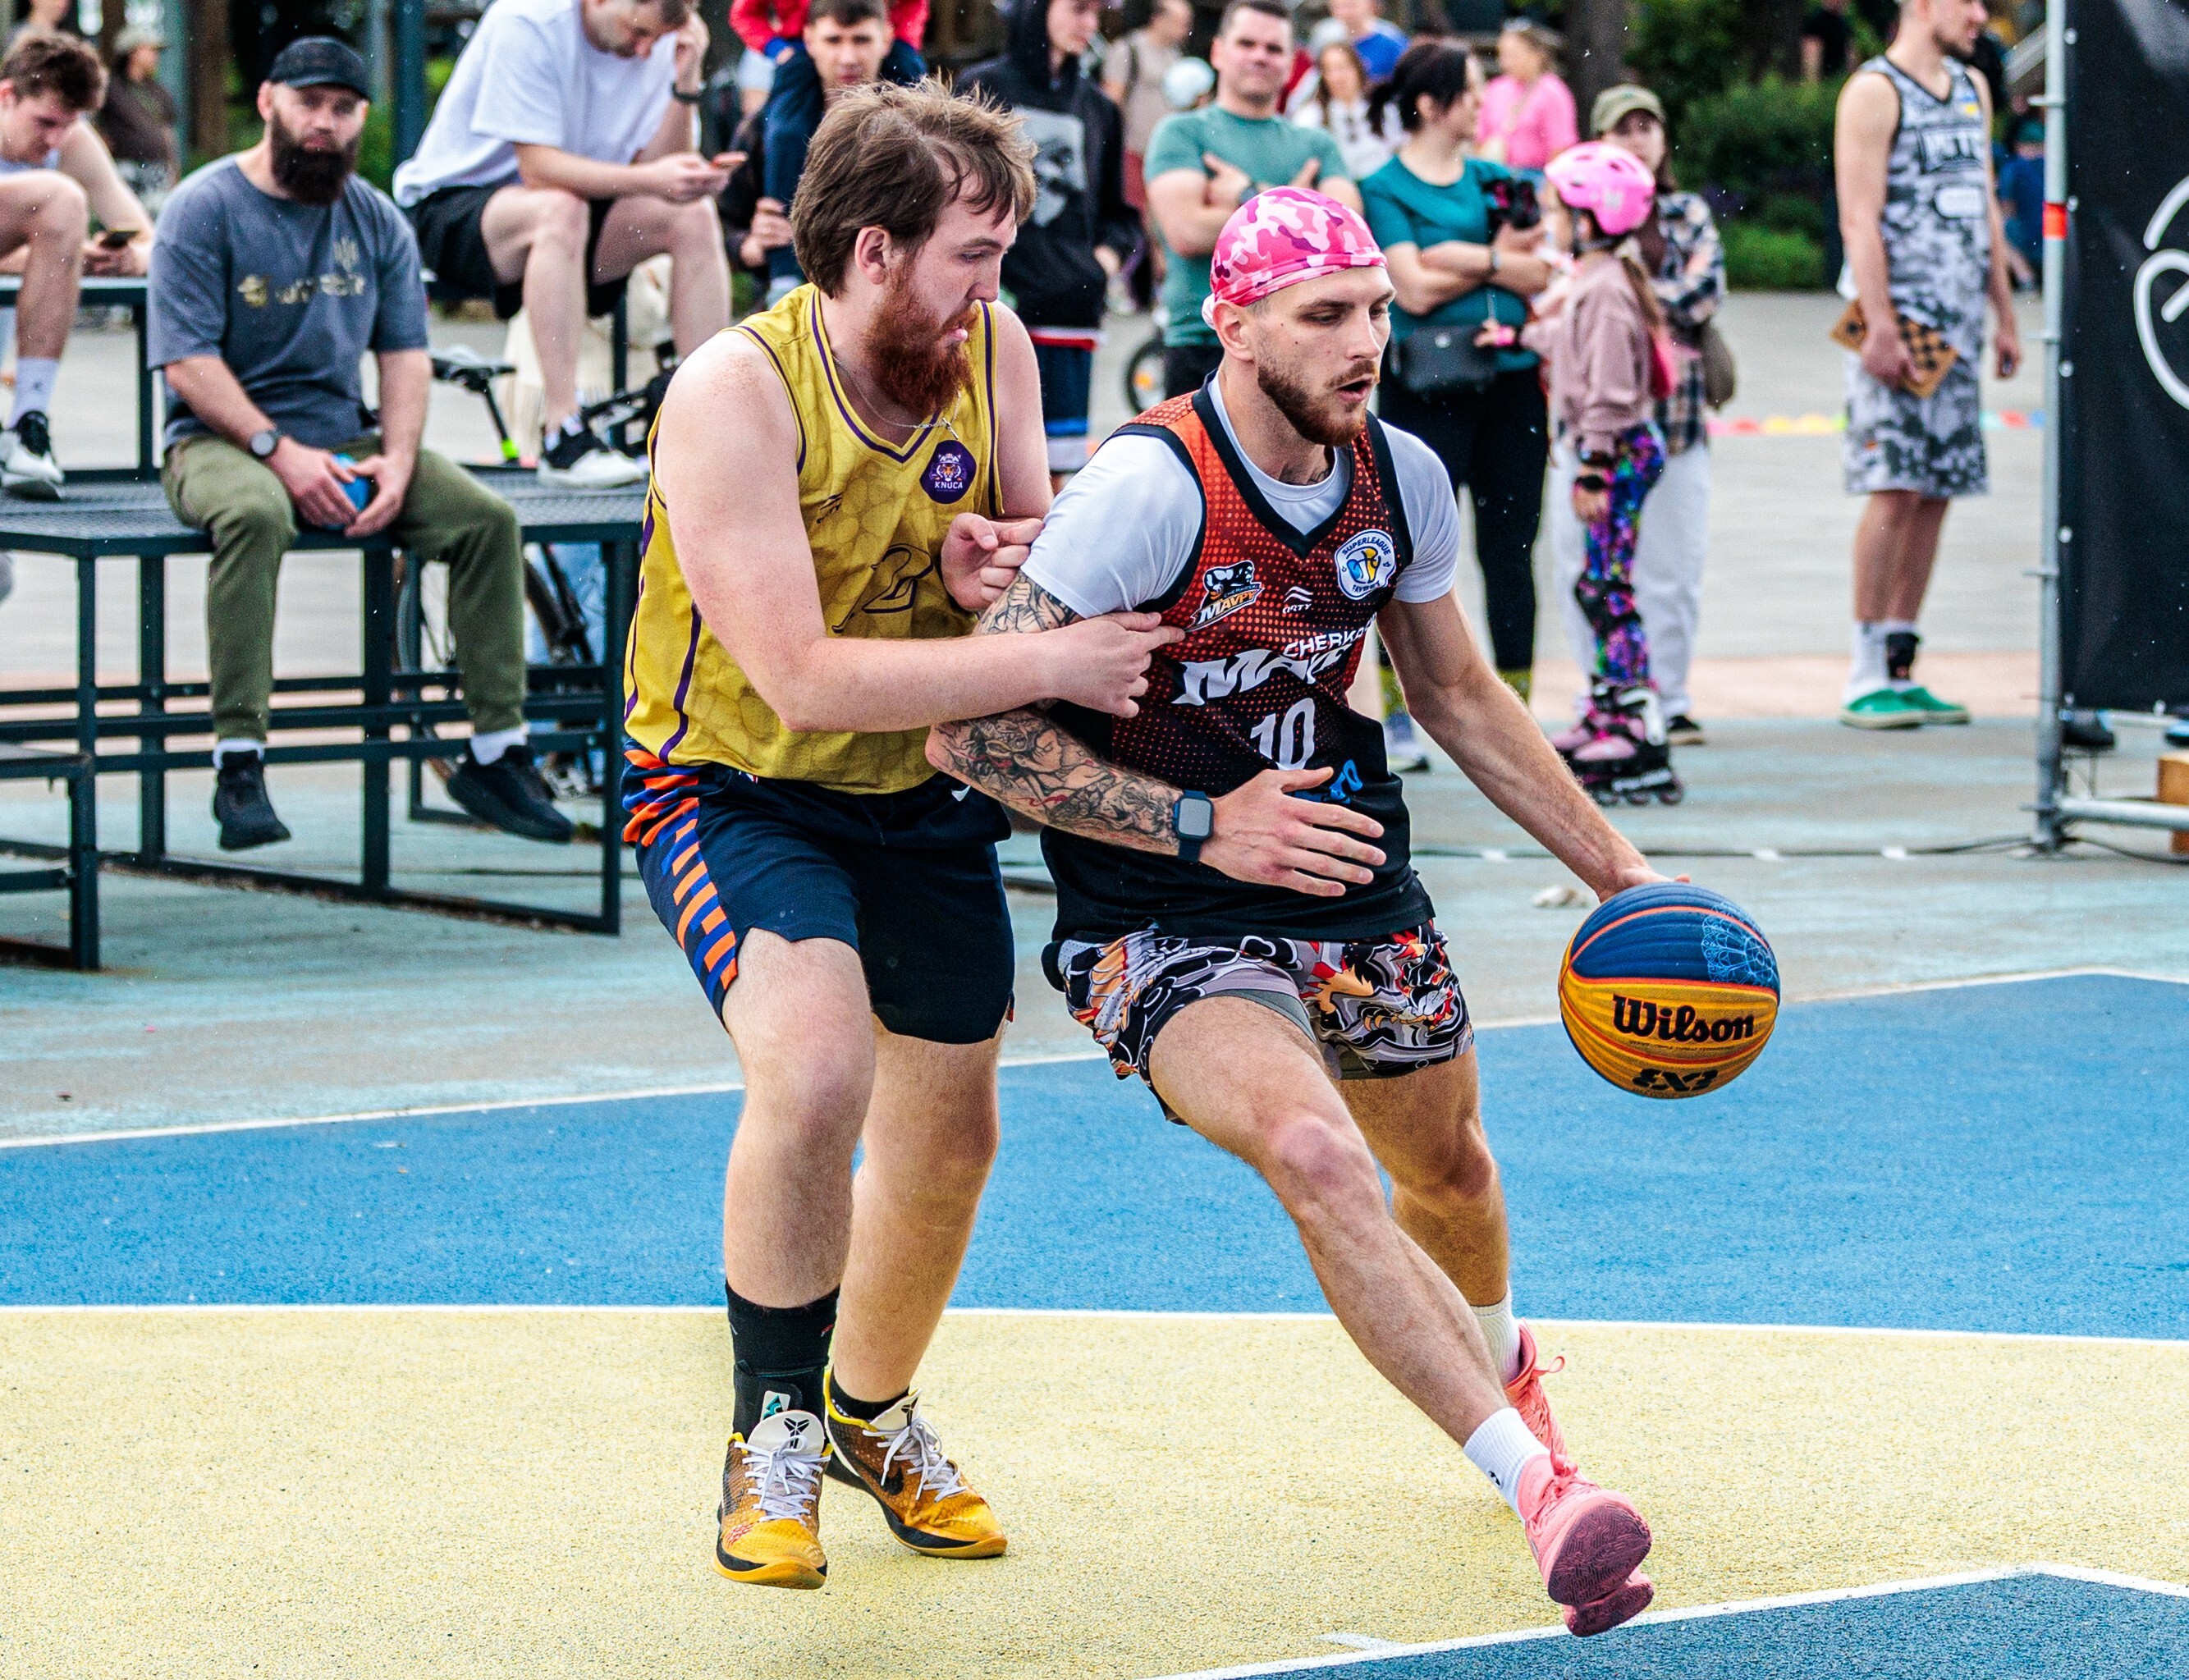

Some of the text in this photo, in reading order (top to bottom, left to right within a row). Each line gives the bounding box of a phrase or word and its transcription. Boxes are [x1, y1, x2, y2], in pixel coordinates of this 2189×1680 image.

[1197, 590, 1256, 625] MAVPY
[1282, 612, 1377, 657] CHERKA
[1250, 698, 1316, 770] 10
[1613, 994, 1755, 1041] Wilson
